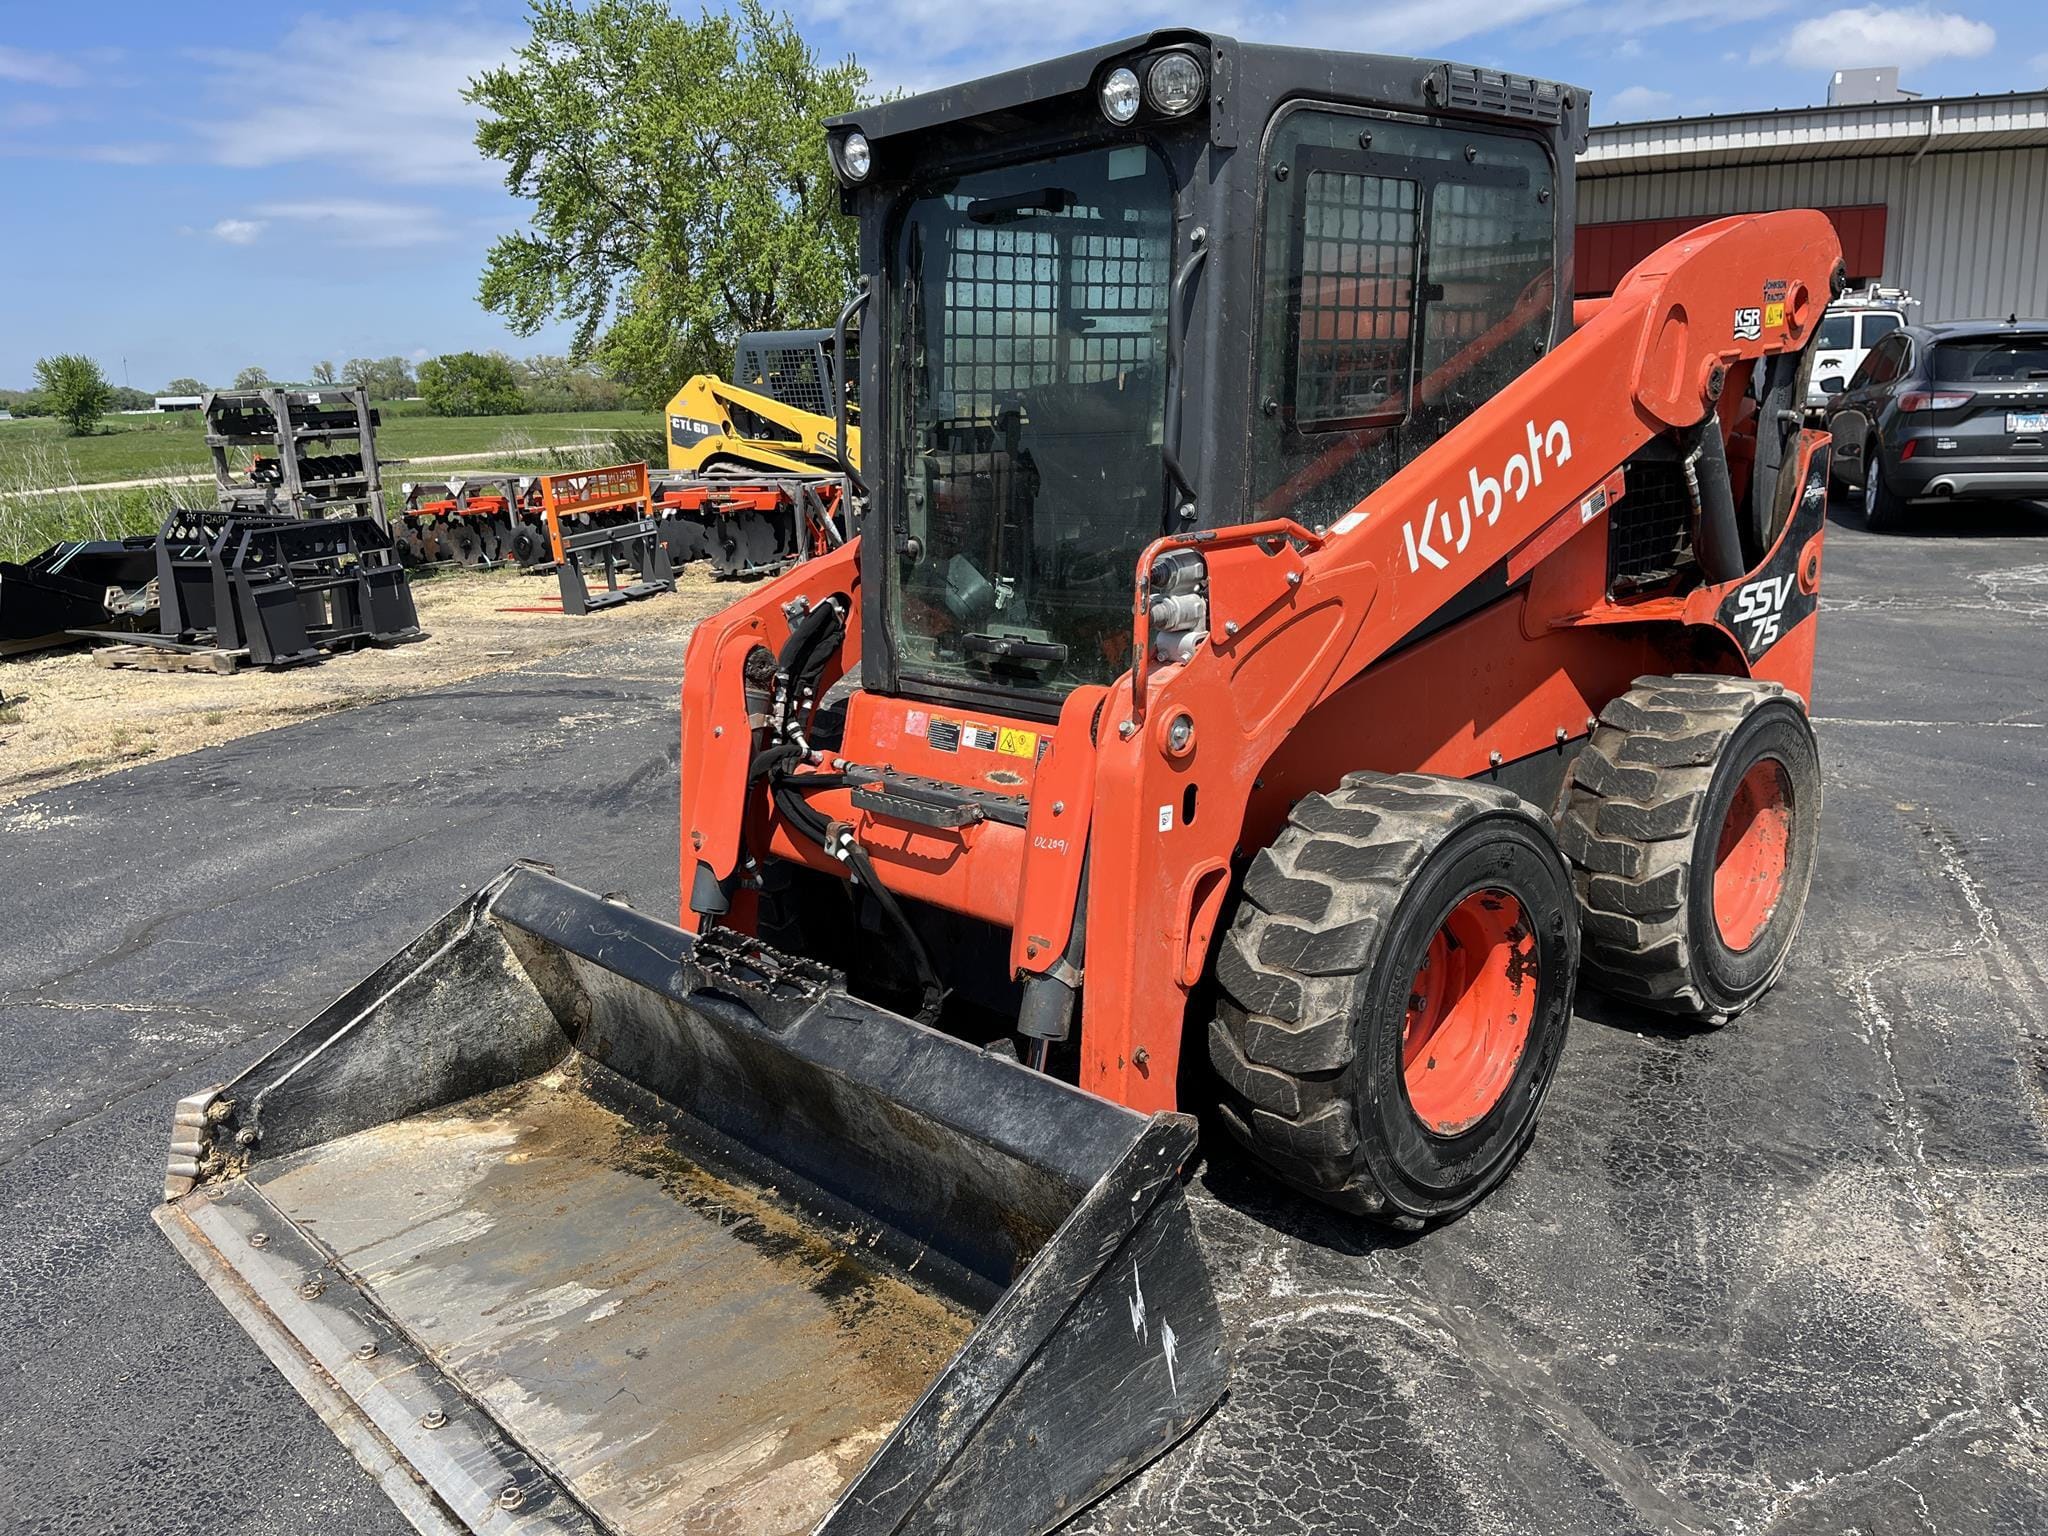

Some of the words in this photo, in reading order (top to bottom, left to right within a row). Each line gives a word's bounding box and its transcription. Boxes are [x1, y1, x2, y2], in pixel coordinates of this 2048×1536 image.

[1734, 308, 1760, 327] KSR
[672, 417, 692, 431] CTL
[693, 422, 709, 435] 60
[1402, 419, 1572, 573] Kubota
[1733, 573, 1796, 624] SSV
[1749, 613, 1781, 649] 75
